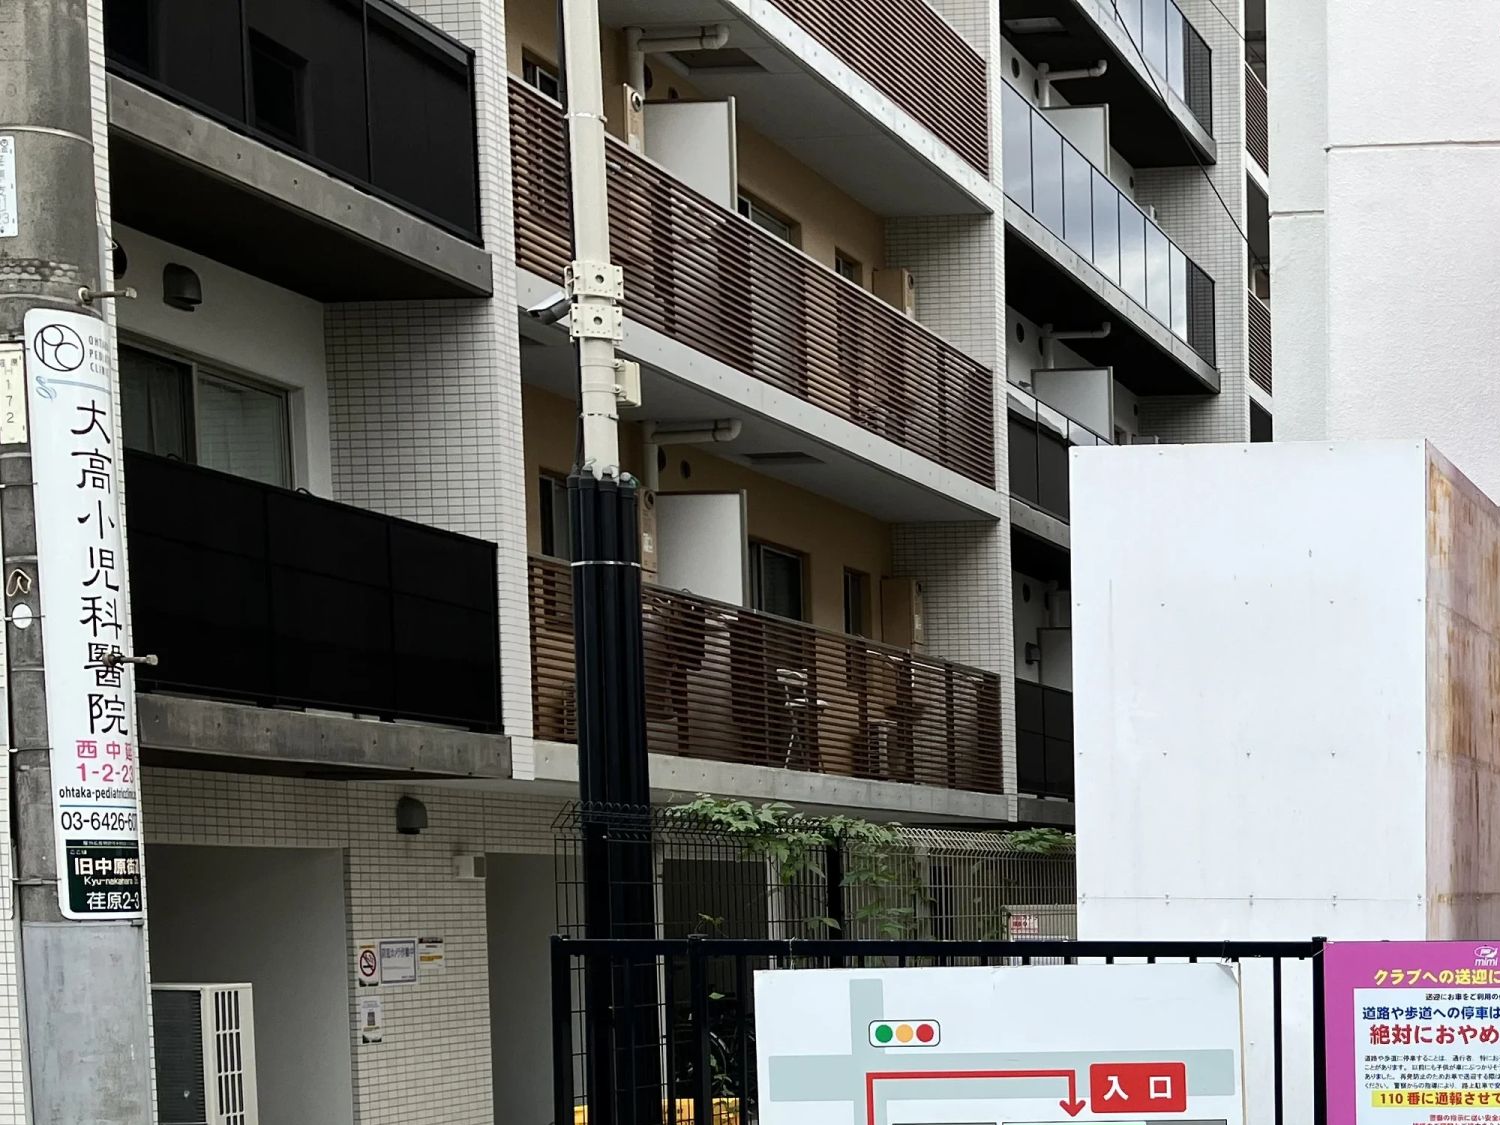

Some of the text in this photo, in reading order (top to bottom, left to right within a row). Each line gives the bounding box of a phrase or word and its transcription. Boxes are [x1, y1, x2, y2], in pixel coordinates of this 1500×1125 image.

[71, 399, 129, 736] 大高小児科醫院
[1474, 957, 1498, 966] mimi
[1103, 1074, 1172, 1101] 入口
